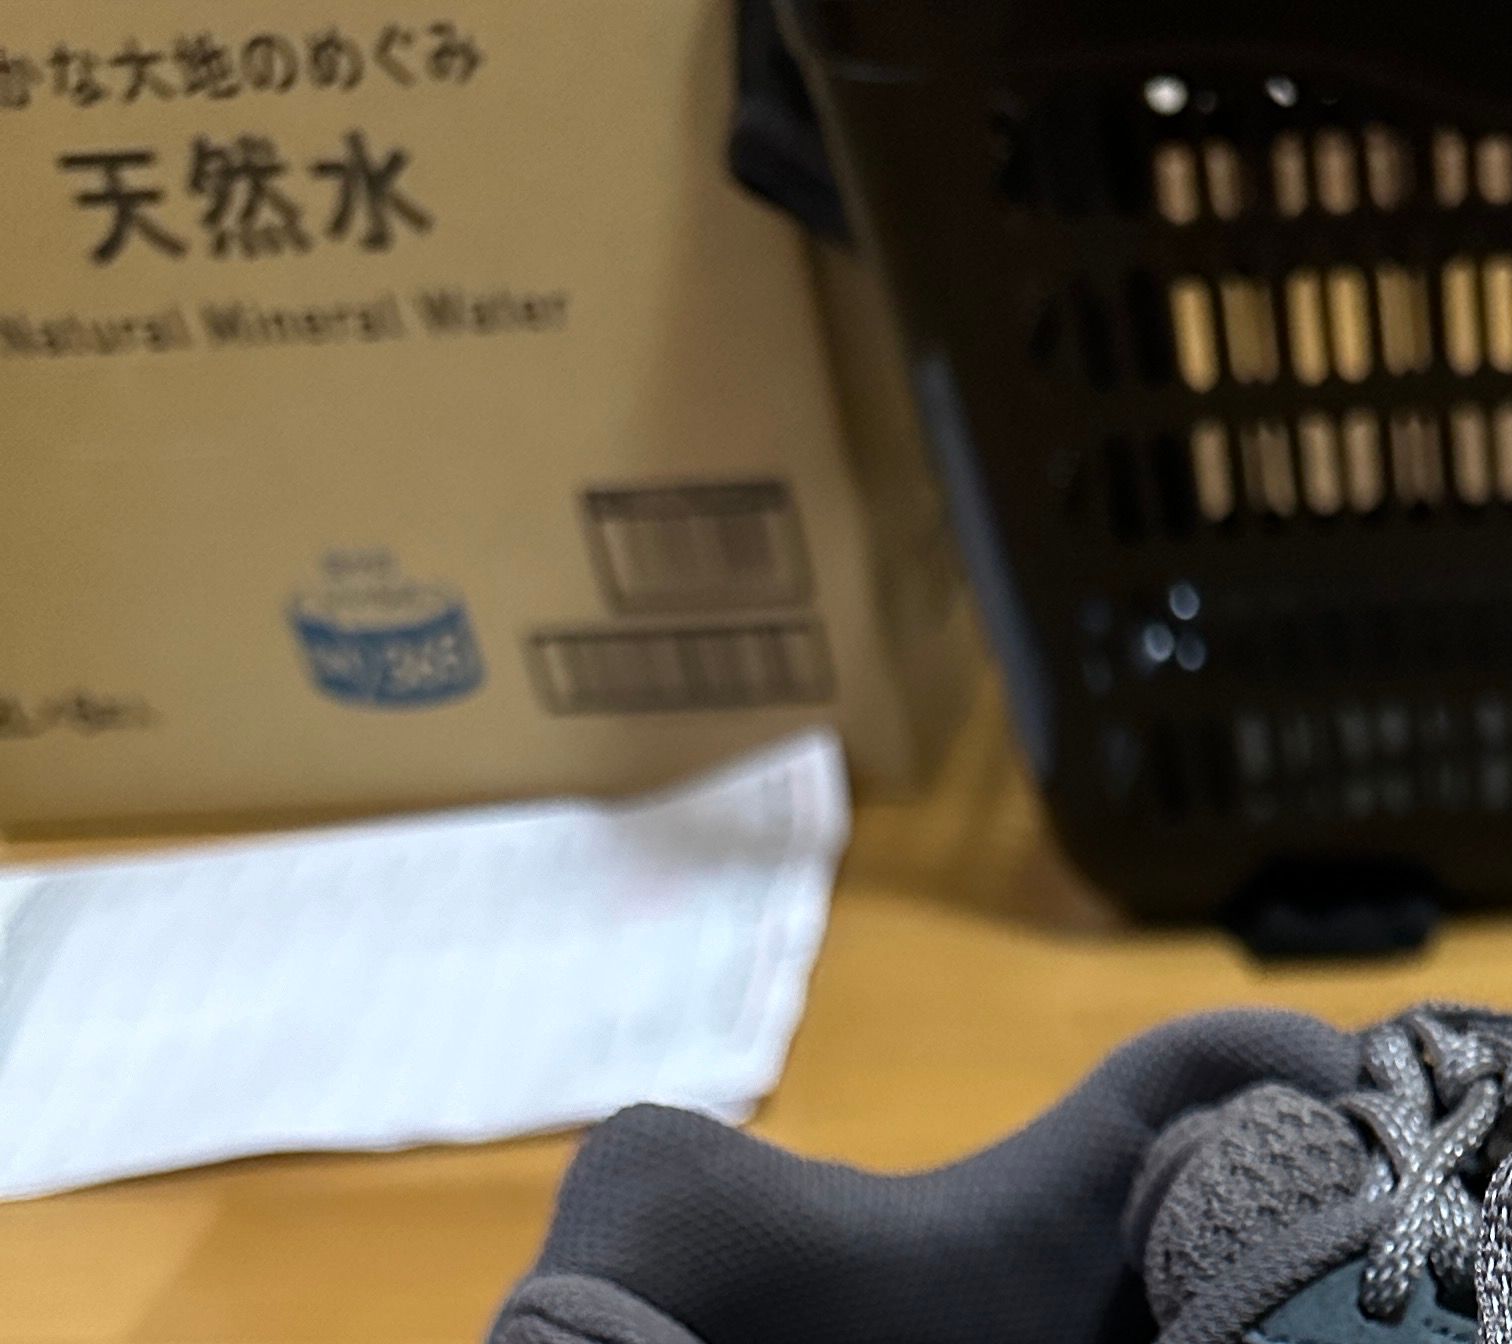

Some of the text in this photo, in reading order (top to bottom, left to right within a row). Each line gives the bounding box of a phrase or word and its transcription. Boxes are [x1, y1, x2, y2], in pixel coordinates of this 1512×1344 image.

[56, 128, 435, 266] 天然水
[415, 286, 569, 335] Water
